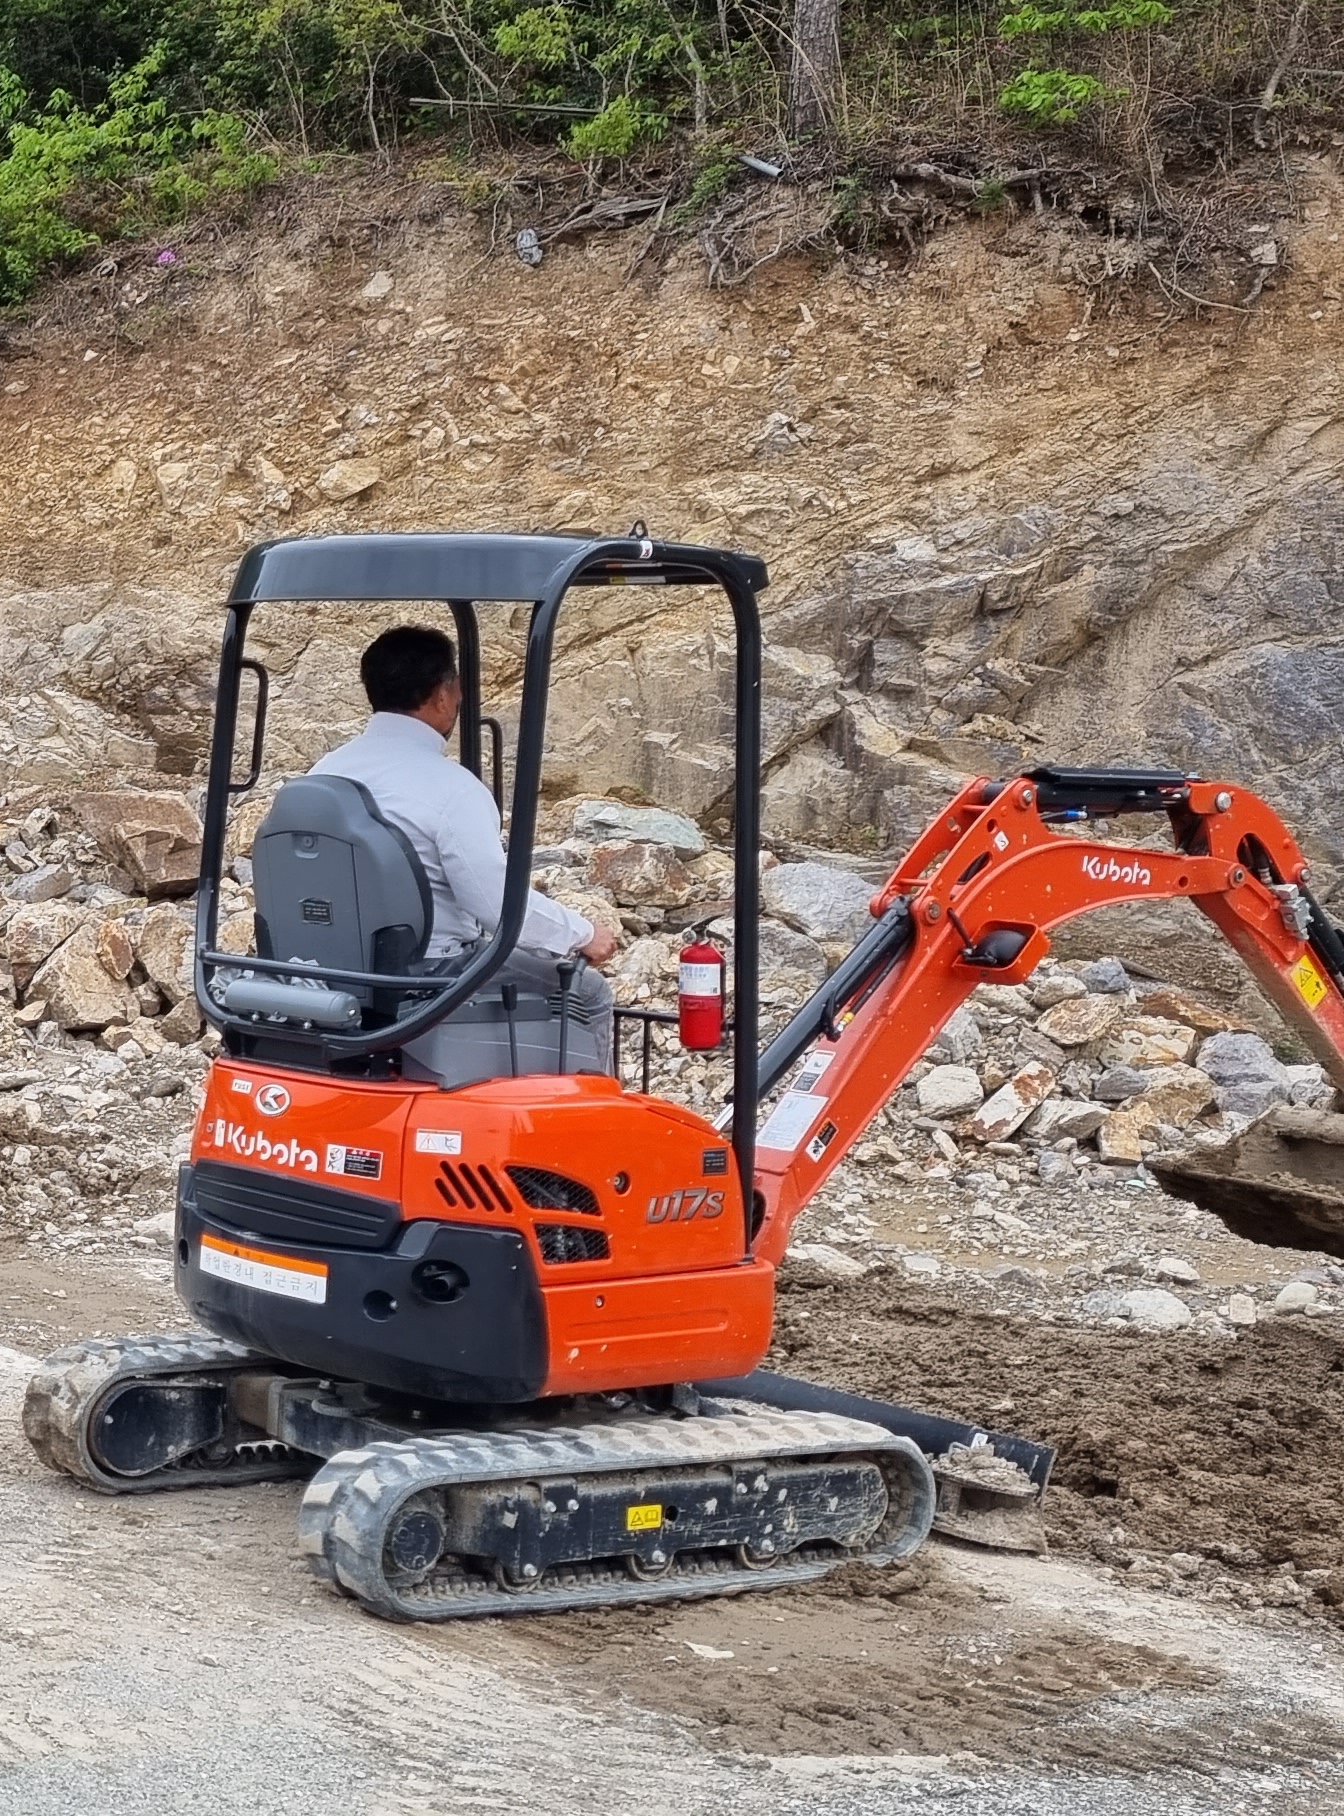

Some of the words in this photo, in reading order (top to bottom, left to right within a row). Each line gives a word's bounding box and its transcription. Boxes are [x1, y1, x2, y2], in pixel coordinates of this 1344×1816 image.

[1082, 855, 1151, 886] Kubota
[227, 1122, 319, 1173] Kubota
[647, 1187, 725, 1224] U17S
